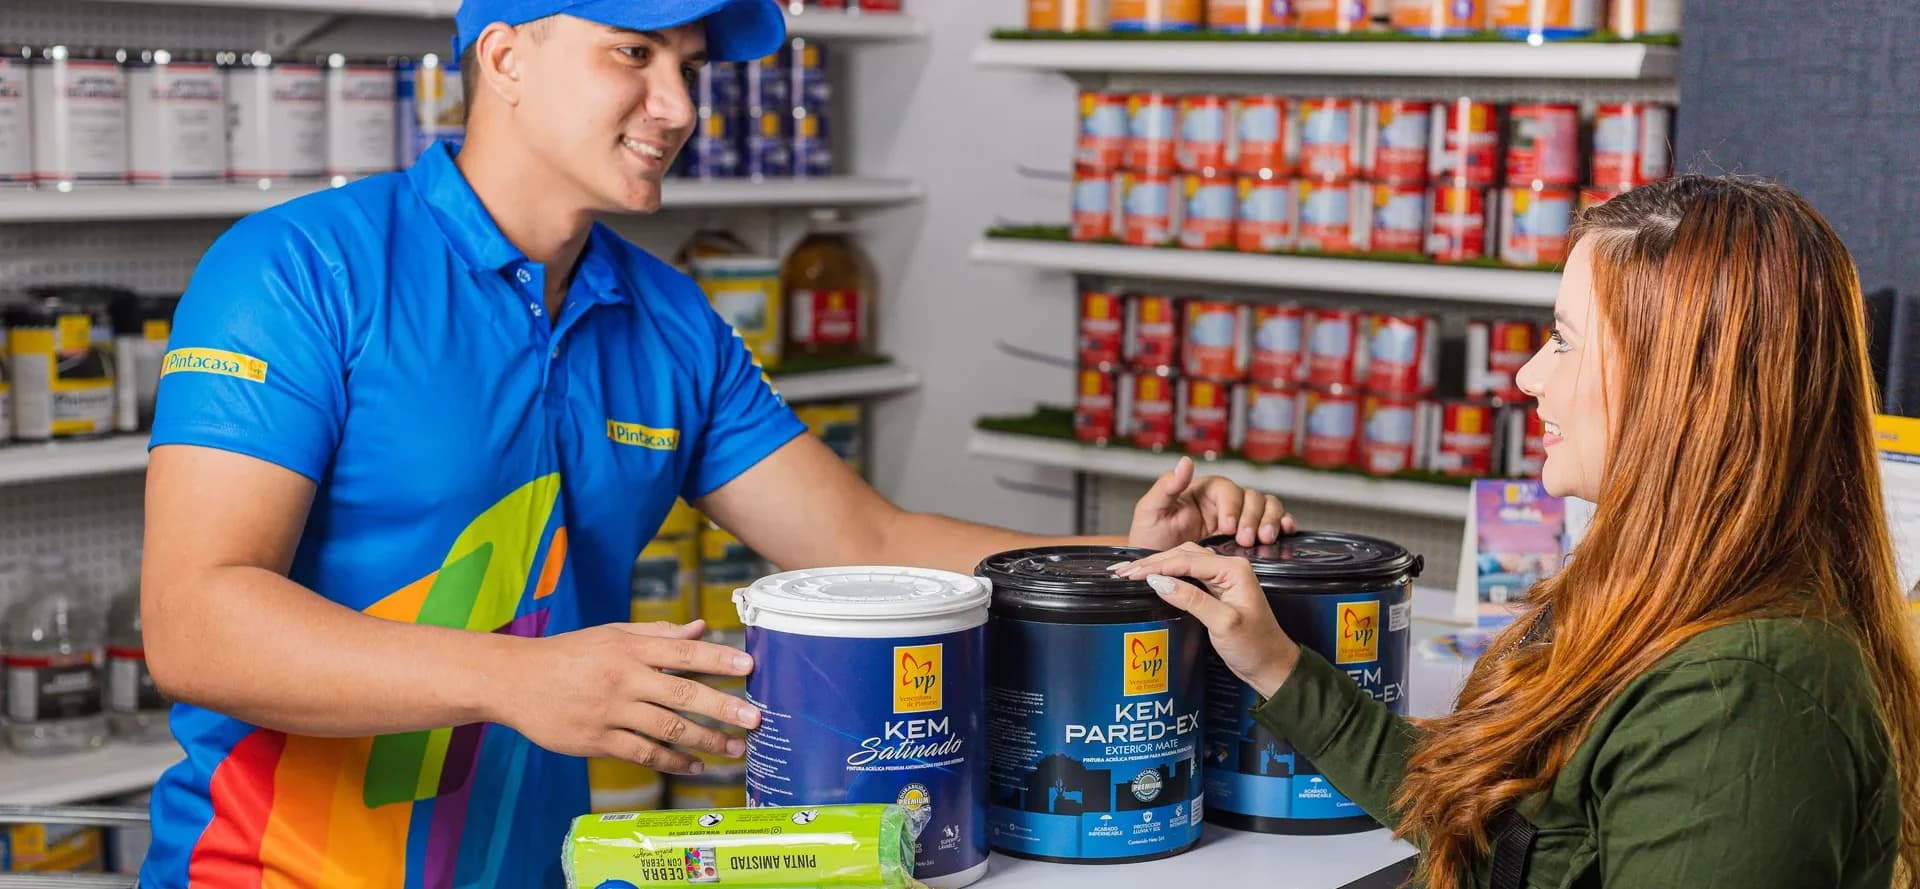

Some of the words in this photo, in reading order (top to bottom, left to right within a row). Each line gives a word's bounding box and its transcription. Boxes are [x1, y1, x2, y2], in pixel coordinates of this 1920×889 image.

[168, 352, 241, 373] Pintacasa
[616, 425, 673, 447] Pintacas
[1354, 628, 1373, 647] vp
[1143, 658, 1162, 677] vp
[913, 673, 936, 694] vp
[1115, 697, 1174, 723] KEM
[885, 716, 949, 741] KEM
[1065, 710, 1199, 744] PARED-EX
[847, 732, 963, 766] Satinado
[1105, 744, 1153, 755] EXTERIOR
[1155, 739, 1179, 751] MATE
[900, 784, 928, 799] DURABILIDAD
[1133, 781, 1161, 791] PREMIUM
[899, 797, 929, 805] PREMIUM
[640, 857, 666, 868] CEBRA
[667, 857, 682, 868] CON
[730, 855, 780, 871] AMISTAD
[783, 854, 816, 869] PINTA
[642, 867, 684, 881] CEBRA
